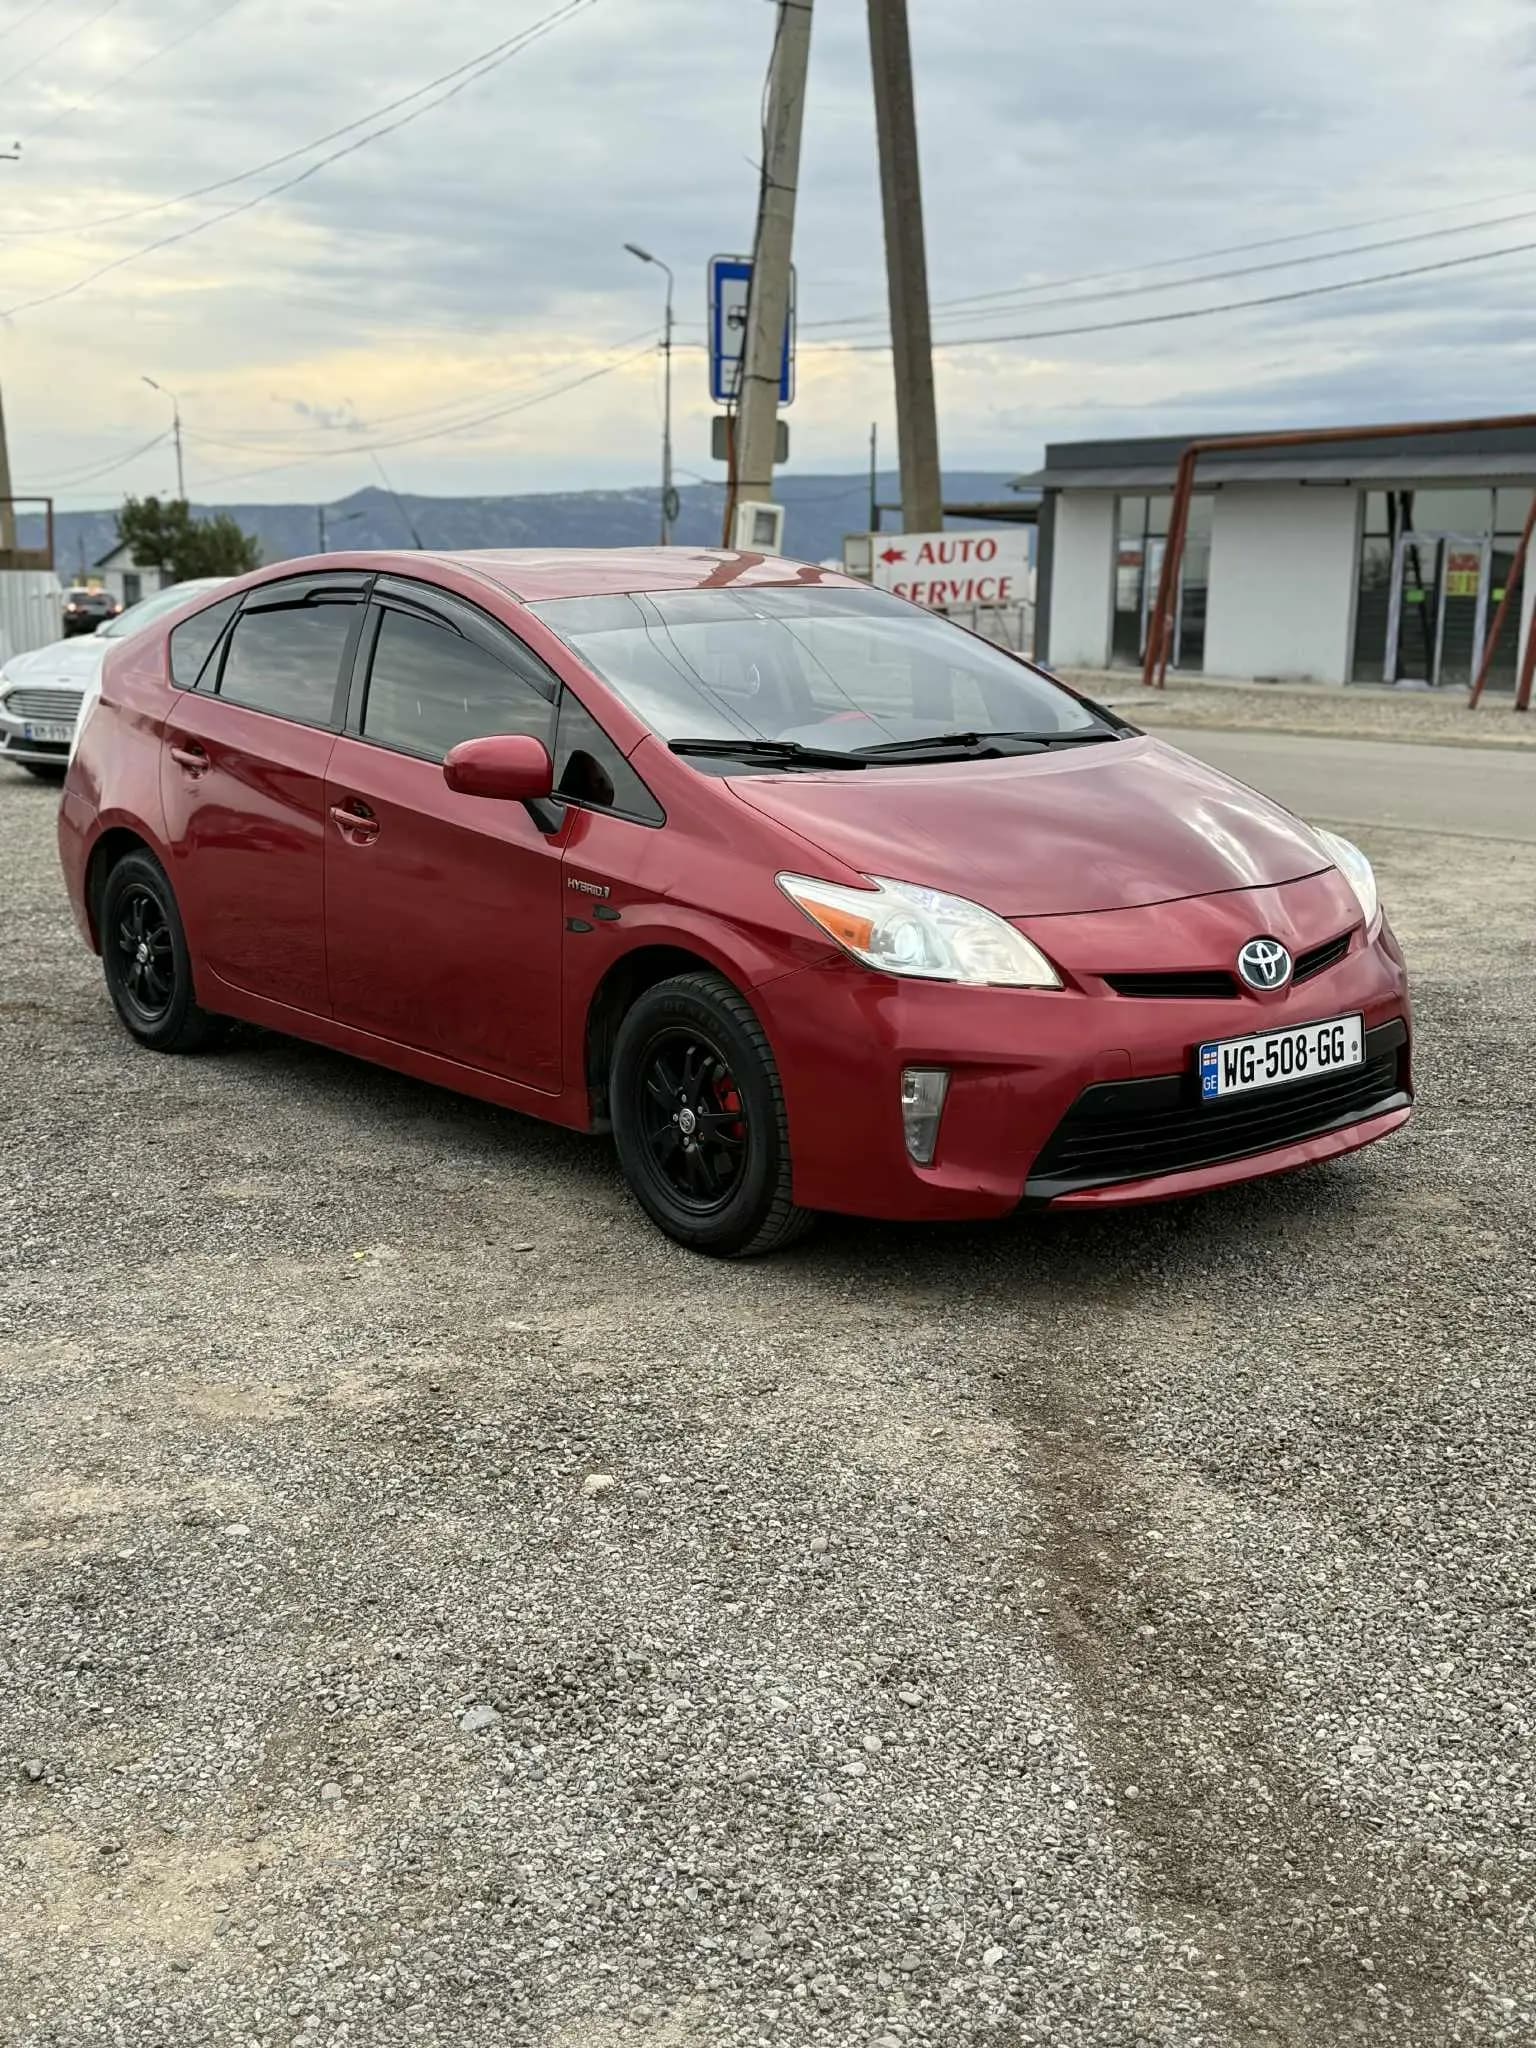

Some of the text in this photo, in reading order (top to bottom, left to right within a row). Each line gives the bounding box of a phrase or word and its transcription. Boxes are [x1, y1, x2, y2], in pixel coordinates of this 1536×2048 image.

[916, 538, 998, 565] AUTO
[893, 576, 1013, 605] SERVICE
[567, 877, 603, 897] HYBRID
[1223, 1025, 1345, 1088] WG-508-GG
[1203, 1074, 1218, 1091] GE
